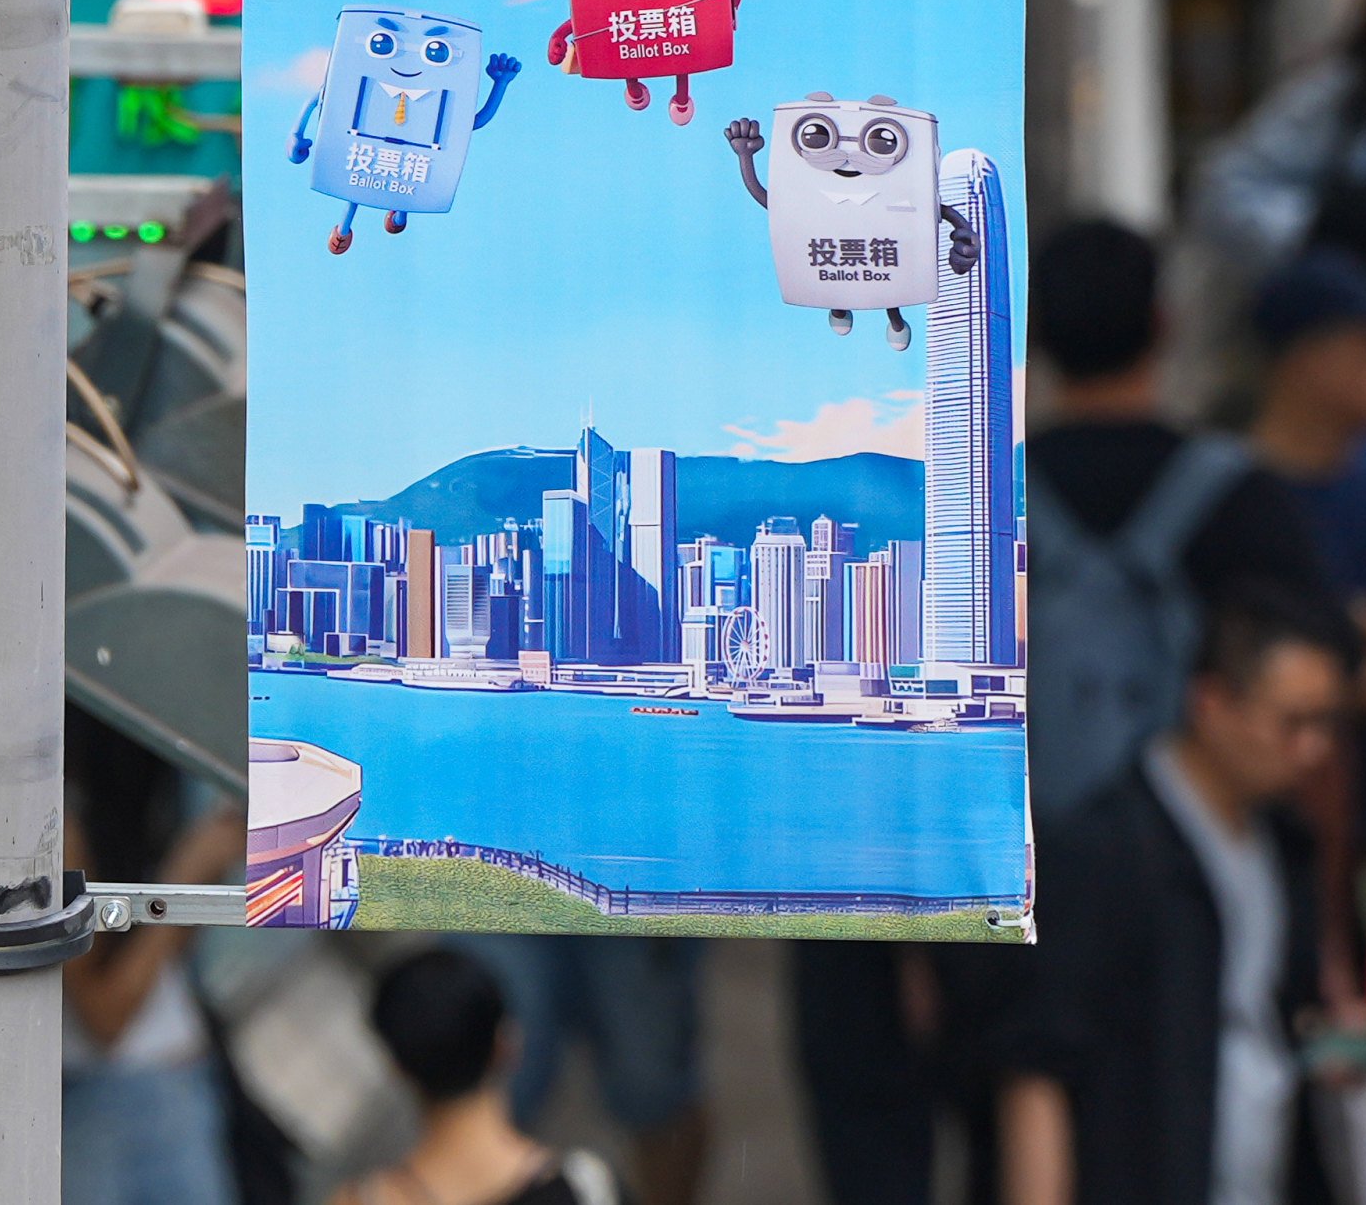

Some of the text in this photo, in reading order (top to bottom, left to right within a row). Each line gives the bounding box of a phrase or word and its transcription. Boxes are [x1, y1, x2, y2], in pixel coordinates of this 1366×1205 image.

[608, 5, 697, 43] 投票箱
[619, 41, 690, 60] Ballot Box
[346, 141, 432, 183] 投票箱
[349, 173, 415, 195] Ballot Box
[807, 237, 899, 267] 投票箱
[819, 269, 891, 281] Ballot Box
